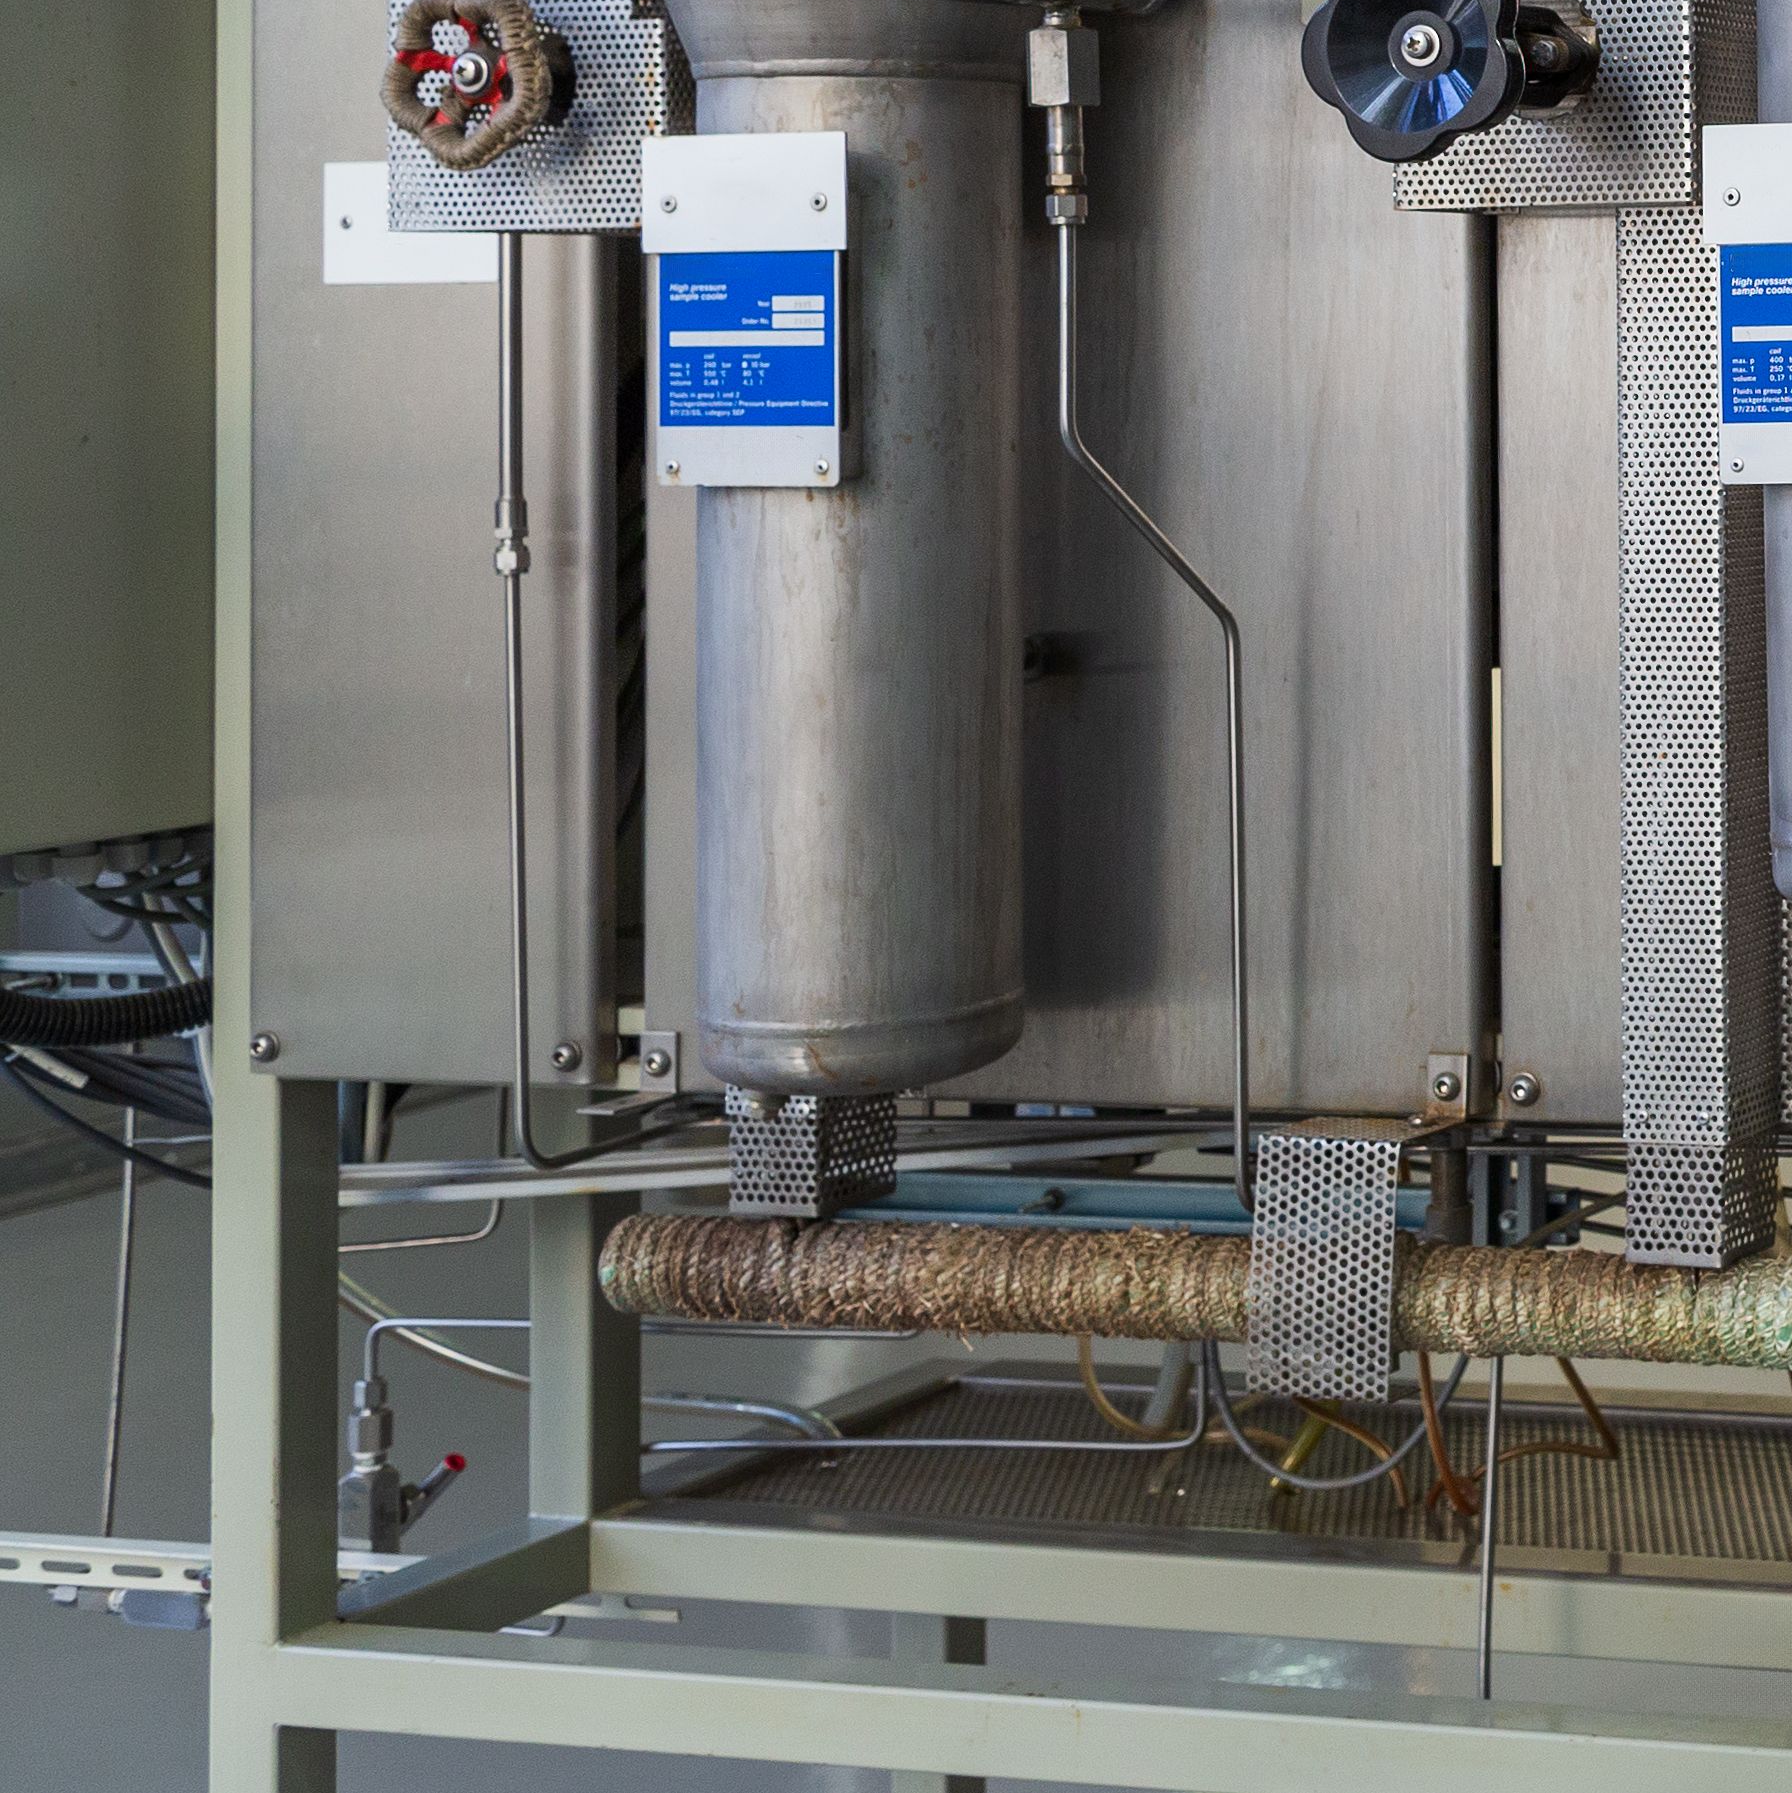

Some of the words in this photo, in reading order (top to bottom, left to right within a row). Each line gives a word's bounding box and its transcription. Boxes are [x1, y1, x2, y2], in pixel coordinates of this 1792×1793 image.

[1731, 278, 1752, 286] High
[1754, 277, 1792, 287] pressure
[669, 284, 689, 293] High
[691, 284, 727, 292] pressure
[1732, 287, 1763, 296] sample
[669, 293, 699, 302] sample
